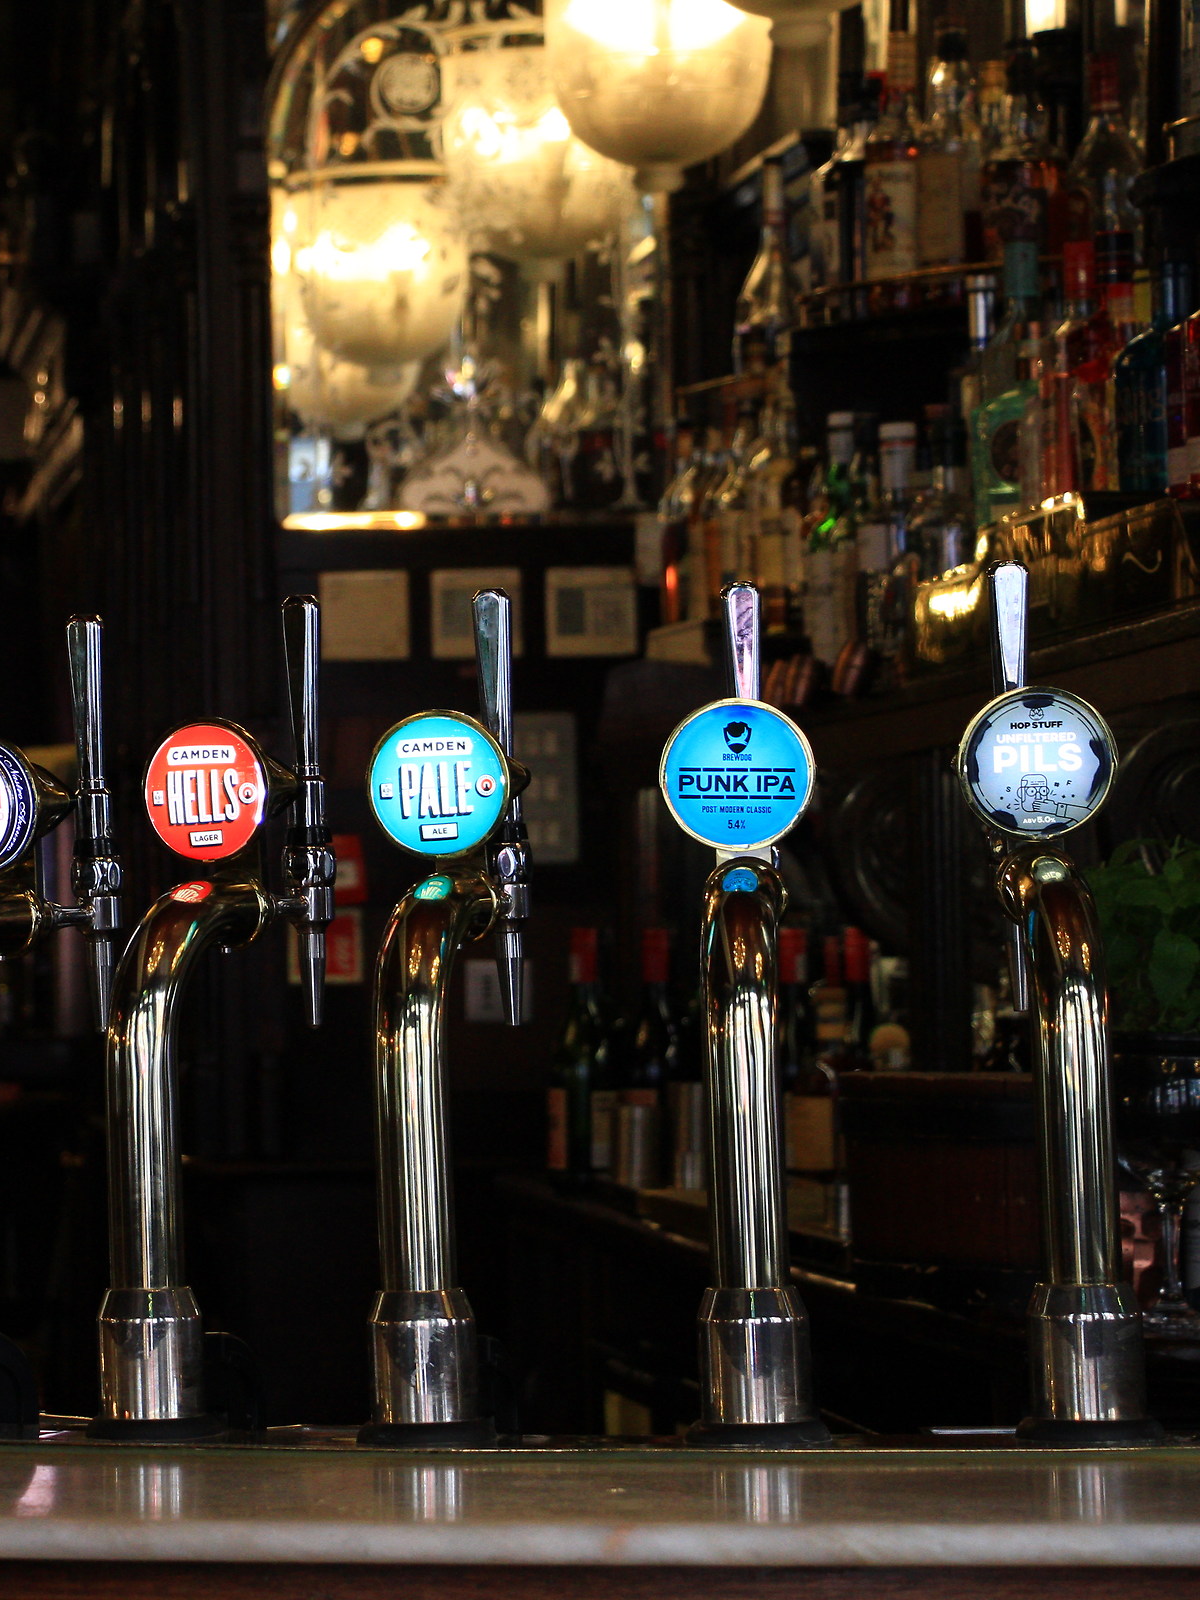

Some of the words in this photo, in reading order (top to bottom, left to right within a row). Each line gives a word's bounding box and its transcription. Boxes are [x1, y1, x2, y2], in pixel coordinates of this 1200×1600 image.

[1010, 721, 1030, 729] HOP
[1032, 720, 1063, 729] STUFF
[996, 732, 1076, 743] UNFILTERED
[402, 741, 466, 753] CAMDEN
[172, 749, 230, 760] CAMDEN
[722, 753, 752, 761] BREWDOG
[993, 743, 1083, 774] PILS
[678, 774, 749, 793] PUNK
[756, 775, 796, 793] IPA
[398, 760, 475, 820] PALE
[166, 768, 241, 826] HELLS
[702, 805, 717, 813] POST
[746, 806, 772, 814] CLASSIC
[727, 819, 746, 829] 5.4%
[1037, 815, 1056, 824] 5.0%
[432, 827, 448, 835] ALE
[194, 834, 219, 842] LAGER
